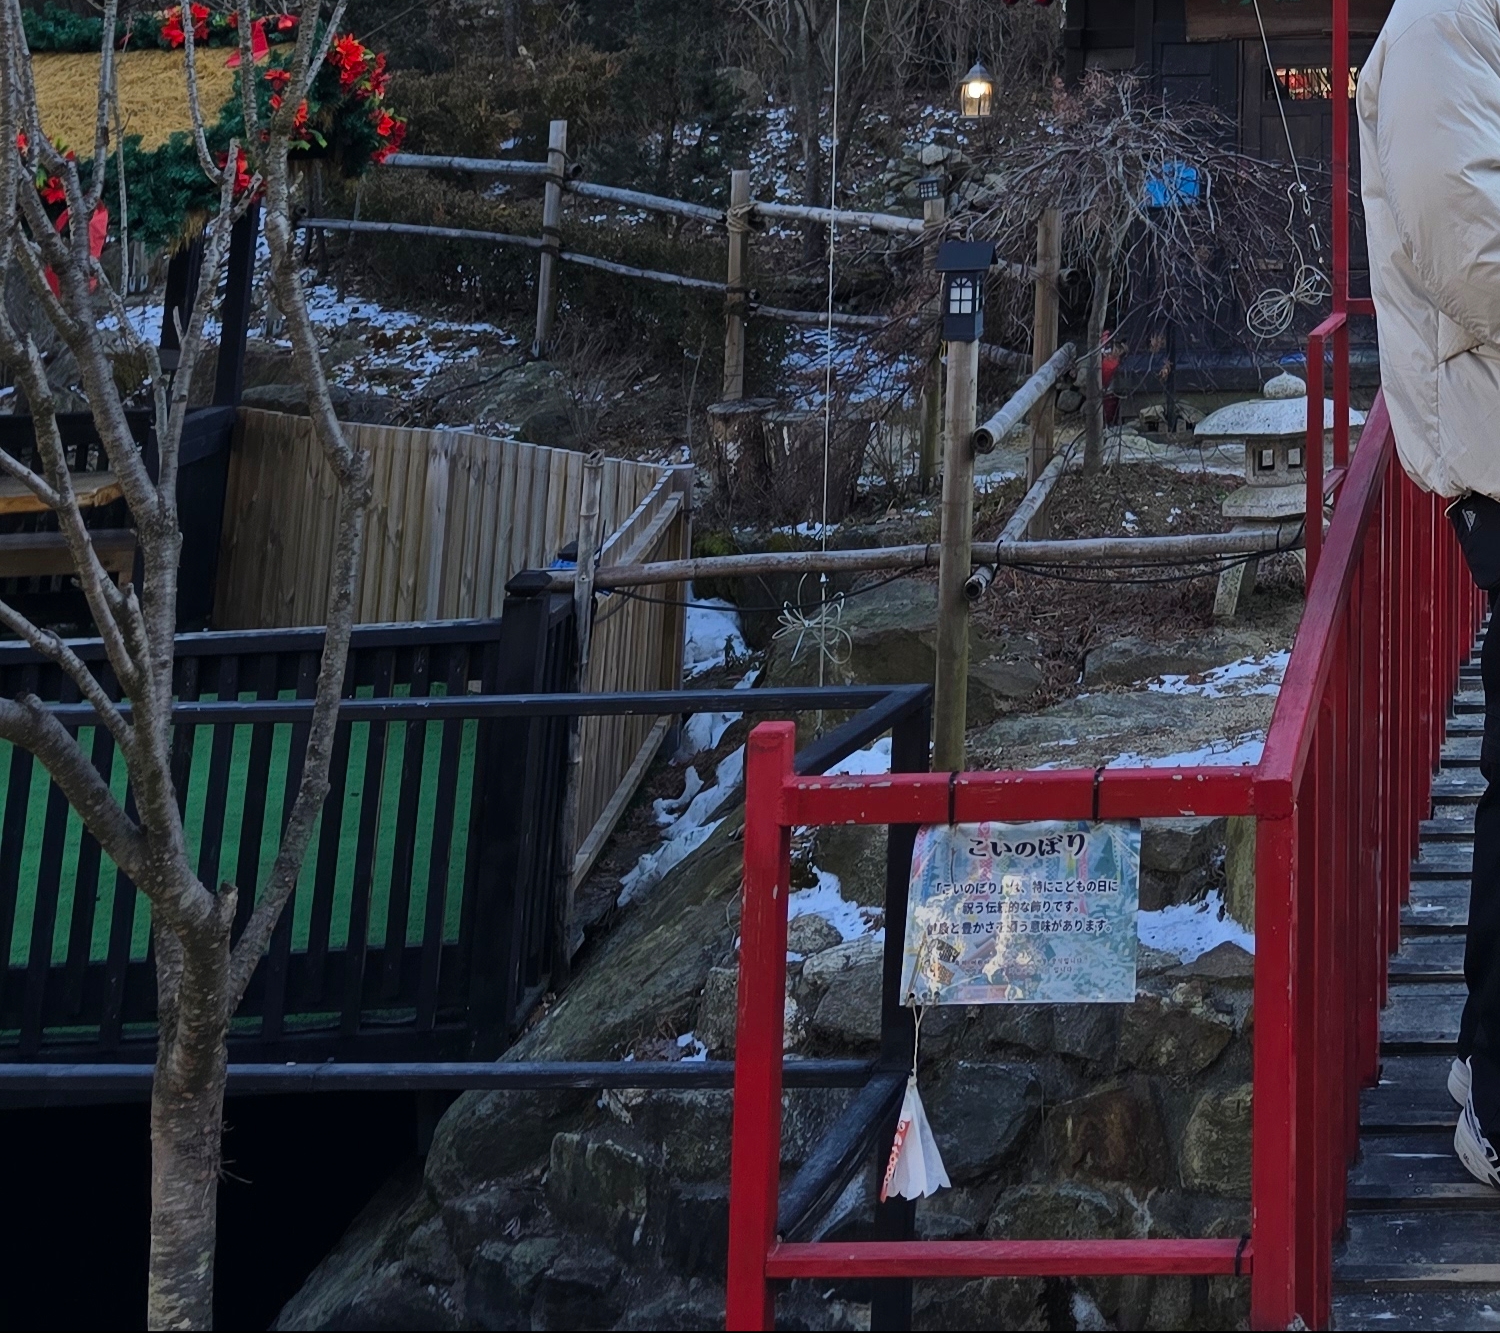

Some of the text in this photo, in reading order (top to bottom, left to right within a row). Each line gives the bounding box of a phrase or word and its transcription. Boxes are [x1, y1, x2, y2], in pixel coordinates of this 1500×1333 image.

[968, 833, 1086, 858] こいのぼり
